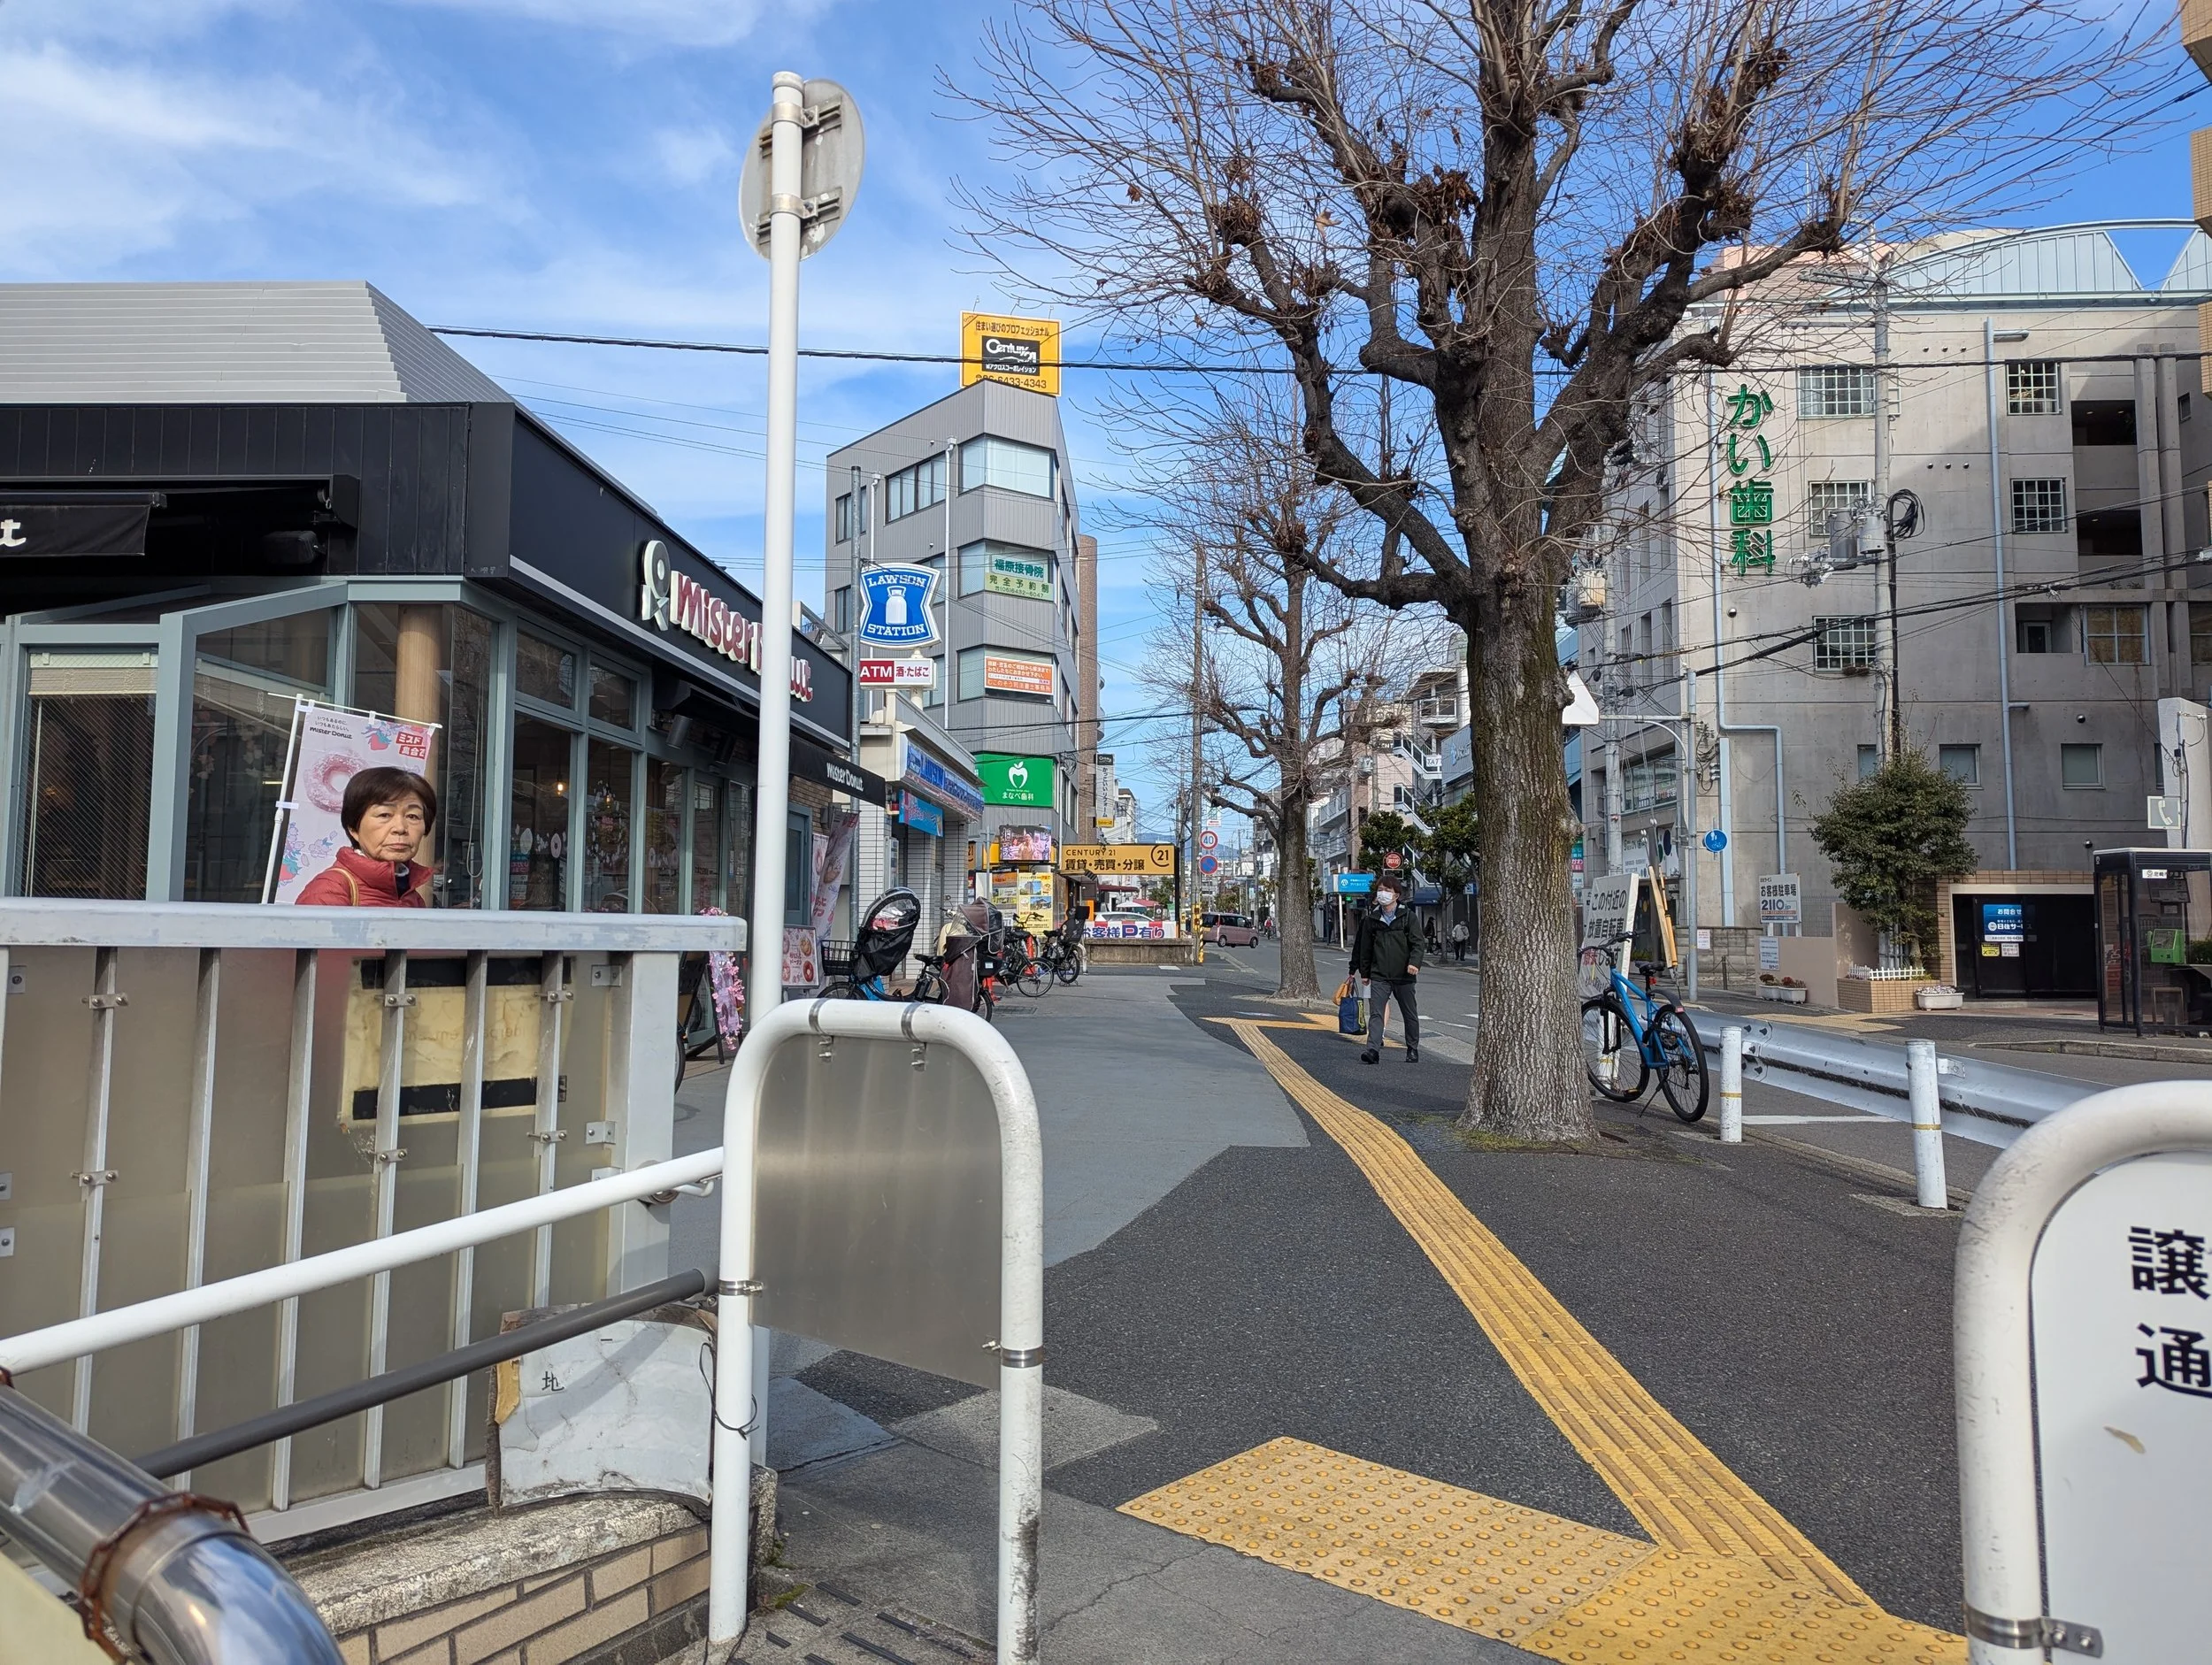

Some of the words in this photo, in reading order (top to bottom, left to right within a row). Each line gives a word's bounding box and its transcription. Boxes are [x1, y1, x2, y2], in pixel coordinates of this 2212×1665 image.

[986, 338, 1029, 357] Century
[1728, 383, 1776, 576] かい歯科
[866, 575, 927, 589] LAWSON
[989, 574, 1049, 594] 完全予約制
[670, 570, 754, 664] Mister
[866, 623, 926, 637] STATION
[860, 665, 893, 678] ATM
[398, 733, 423, 744] ミスド
[1203, 835, 1214, 845] 40
[1064, 858, 1145, 871] 賃貸・売買・分譲
[1156, 849, 1169, 861] 21
[1592, 889, 1627, 910] この付近の
[1587, 917, 1624, 938] 放置自転車
[2128, 1226, 2211, 1301] 譲
[2135, 1323, 2212, 1399] 通
[541, 1371, 565, 1392] 地
